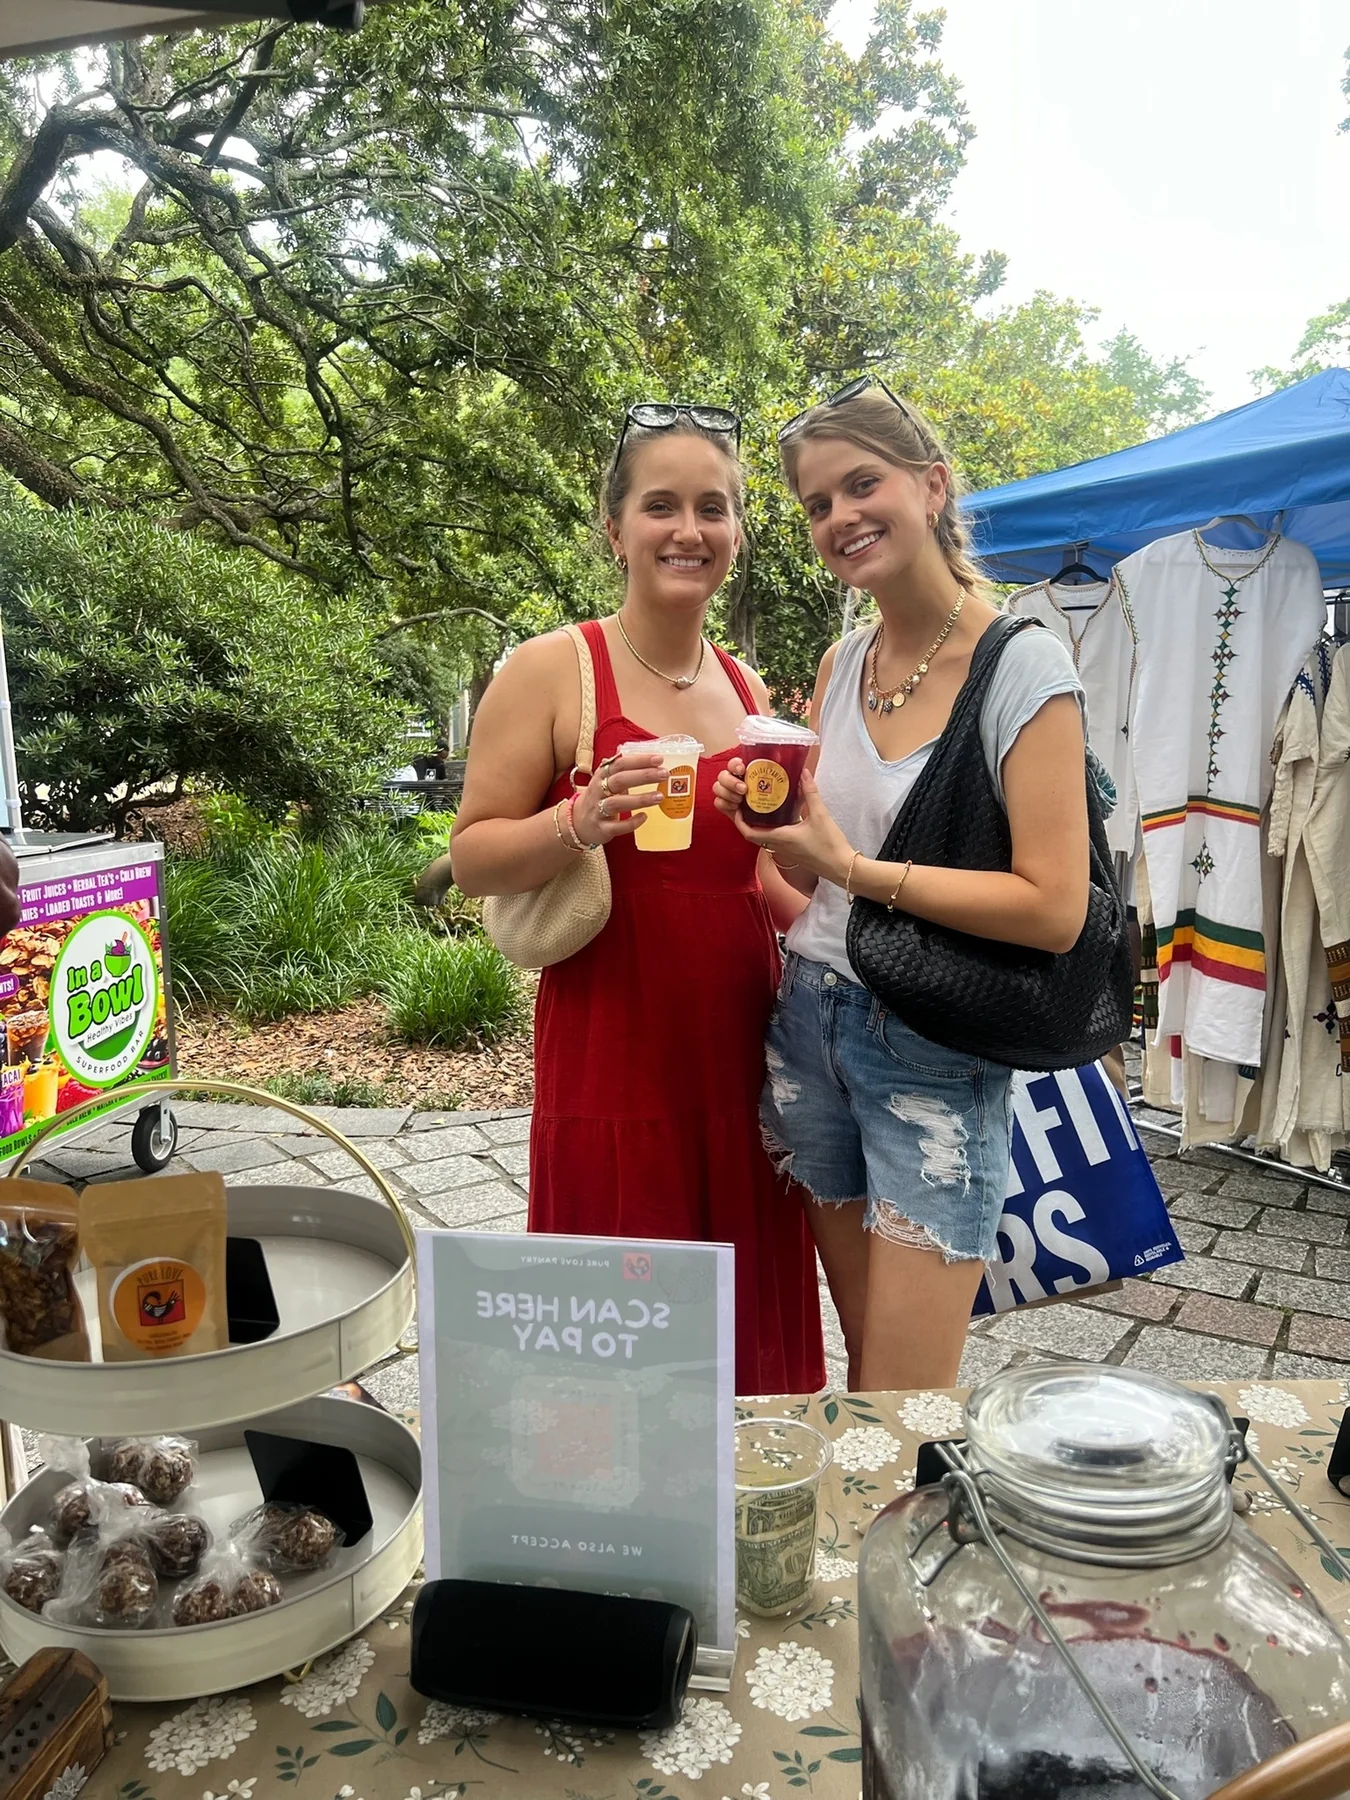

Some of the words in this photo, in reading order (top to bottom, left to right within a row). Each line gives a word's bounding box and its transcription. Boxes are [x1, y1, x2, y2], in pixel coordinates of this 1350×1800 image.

[21, 888, 42, 903] FRUIT
[43, 883, 67, 899] JUICES
[72, 877, 97, 892] HERBAL
[120, 869, 135, 883] COLD
[135, 866, 152, 880] BREW
[20, 906, 39, 922] HIES
[45, 900, 71, 916] LOADED
[71, 895, 95, 910] TOASTS
[104, 887, 123, 903] MORE!
[67, 966, 88, 992] In
[90, 960, 103, 982] a
[86, 1023, 113, 1042] Healthy
[114, 1013, 133, 1027] Vibes
[76, 1055, 128, 1073] SUPERFOOD
[131, 1031, 144, 1053] BAR
[1005, 1062, 1139, 1199] FI
[971, 1190, 1110, 1320] RS
